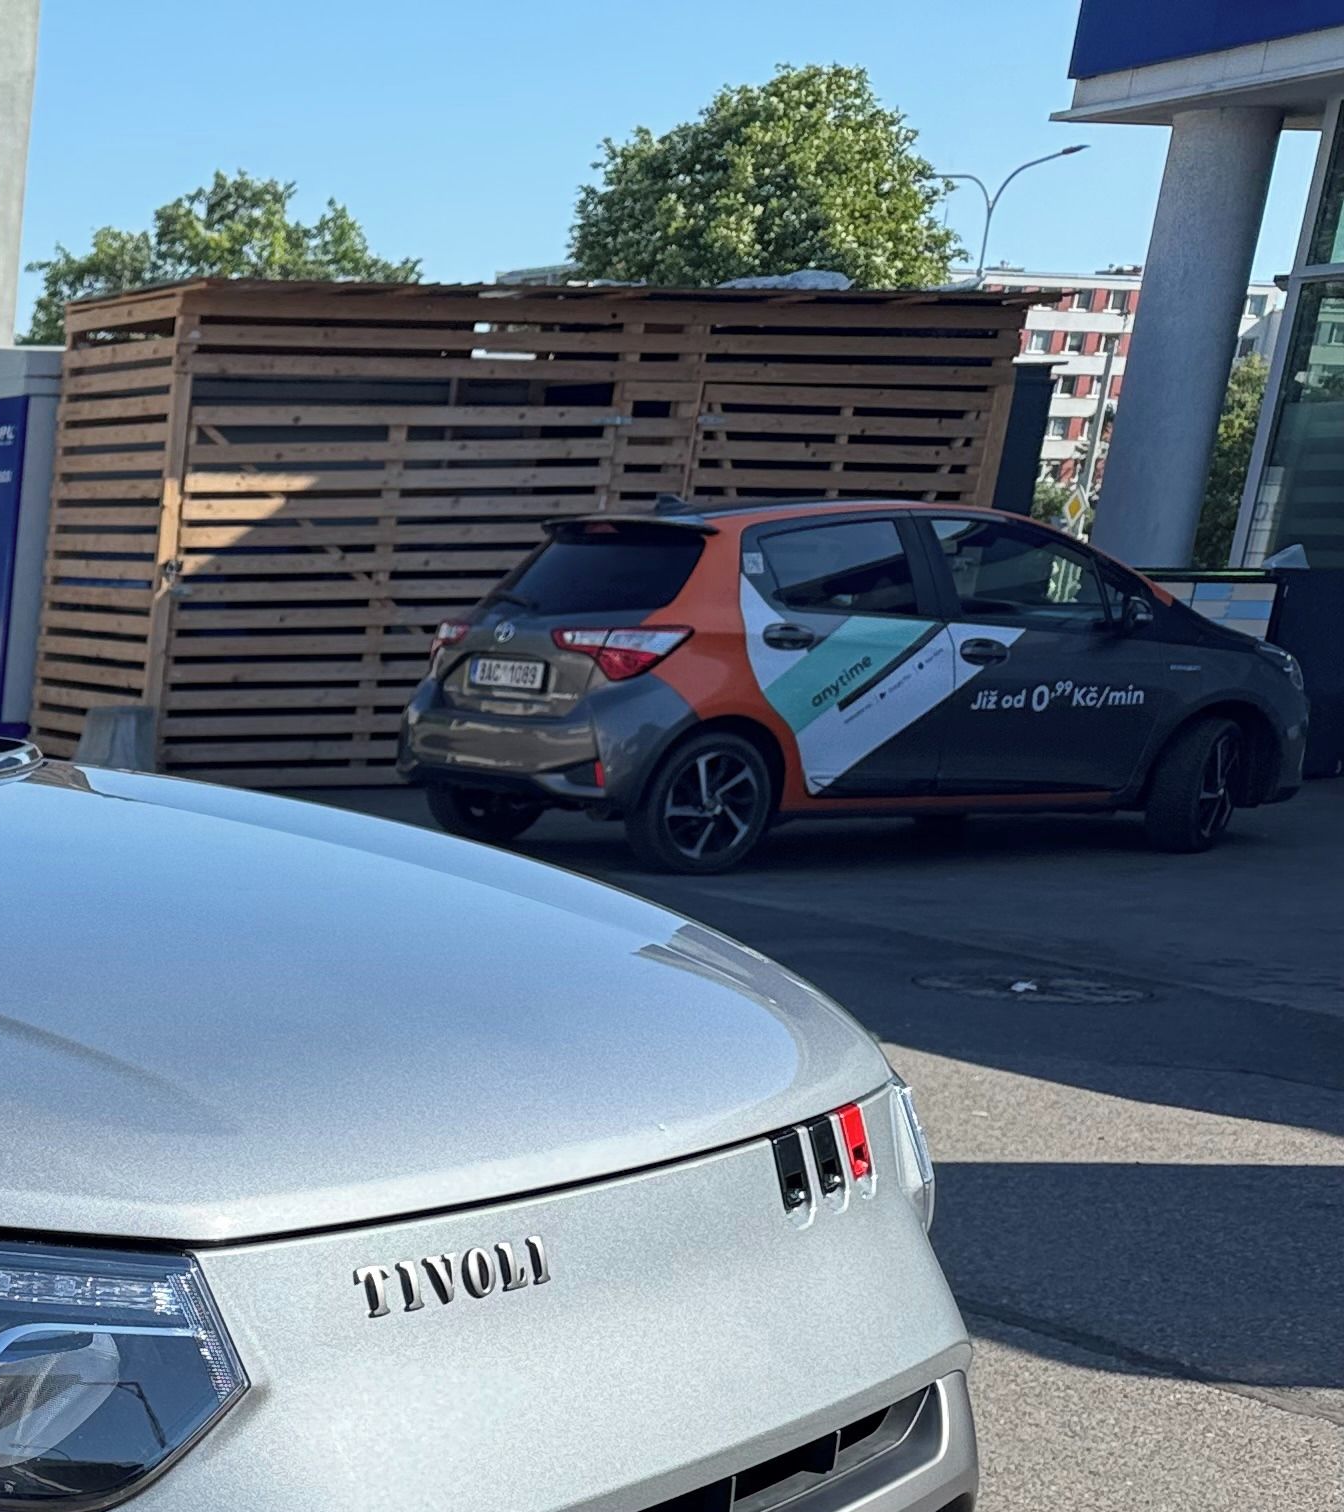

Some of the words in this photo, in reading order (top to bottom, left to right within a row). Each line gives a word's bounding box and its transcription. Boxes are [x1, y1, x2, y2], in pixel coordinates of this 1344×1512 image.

[811, 655, 873, 708] anytime
[970, 689, 998, 711] Již
[1001, 689, 1027, 710] od
[1072, 684, 1145, 709] Kč/min
[352, 1234, 552, 1319] TIVOLI
